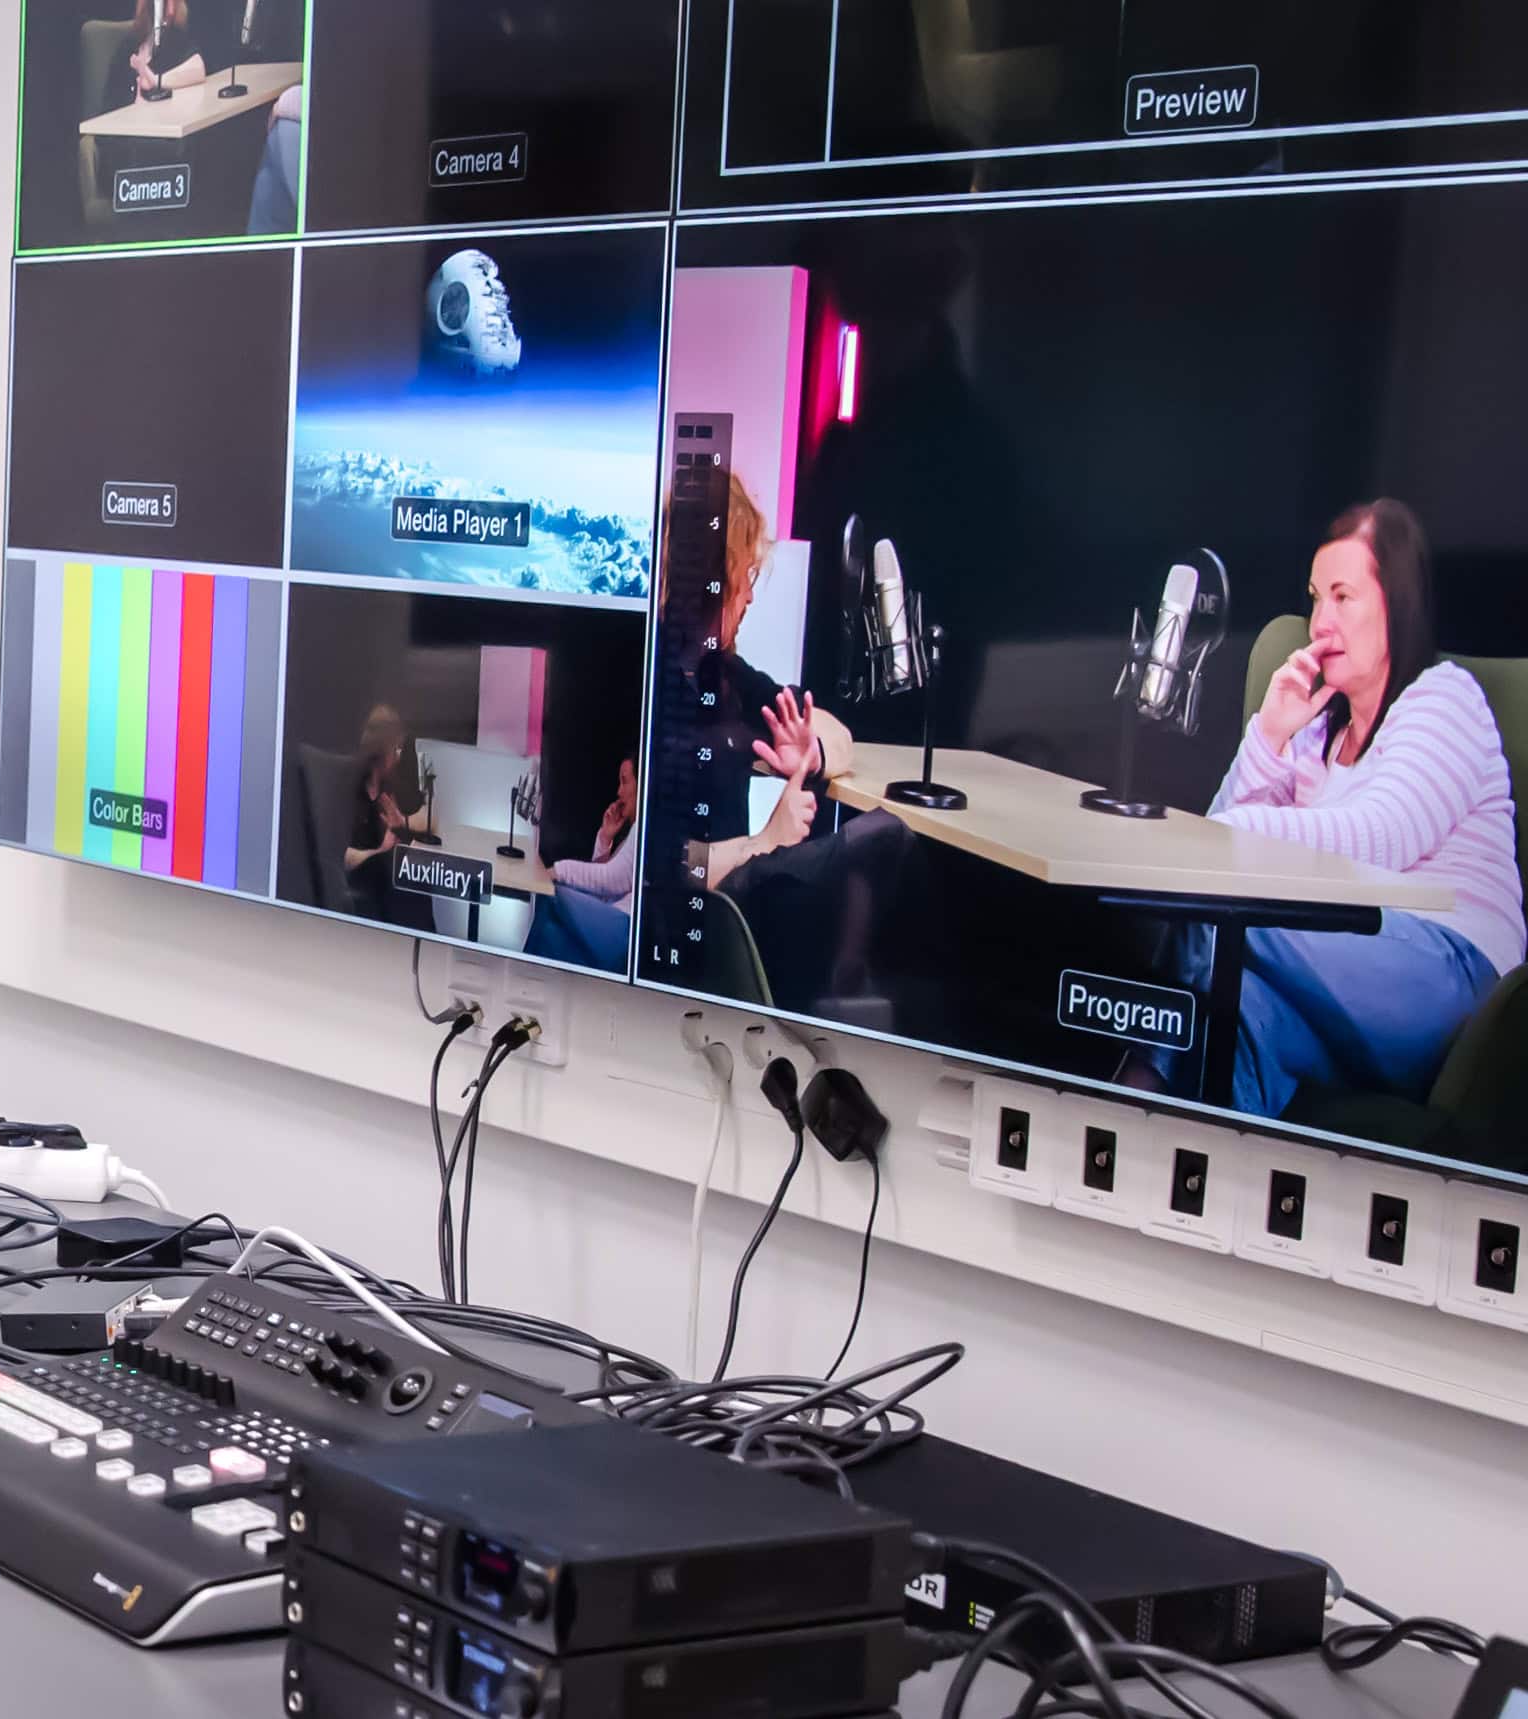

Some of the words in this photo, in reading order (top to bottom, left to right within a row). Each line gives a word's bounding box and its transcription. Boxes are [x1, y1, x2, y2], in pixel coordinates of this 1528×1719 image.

[1136, 83, 1247, 120] Preview
[435, 150, 503, 176] Camera
[508, 144, 519, 168] 4
[119, 178, 172, 202] Camera
[175, 174, 184, 197] 3
[713, 453, 721, 467] 0
[107, 491, 159, 516] Camera
[162, 494, 171, 517] 5
[397, 506, 448, 533] Media
[453, 508, 508, 541] Player
[514, 512, 522, 537] 1
[709, 517, 720, 530] -5
[706, 581, 720, 594] -10
[703, 637, 717, 650] -15
[700, 692, 715, 705] -20
[697, 748, 712, 761] -25
[93, 797, 129, 823] Color
[131, 804, 163, 830] Bars
[694, 804, 709, 816] -30
[398, 855, 471, 897] Auxiliary
[477, 870, 485, 895] 1
[691, 866, 705, 878] -40
[689, 898, 703, 911] -50
[687, 929, 702, 942] -60
[653, 946, 661, 961] L
[670, 949, 679, 964] R
[1069, 984, 1183, 1036] Program
